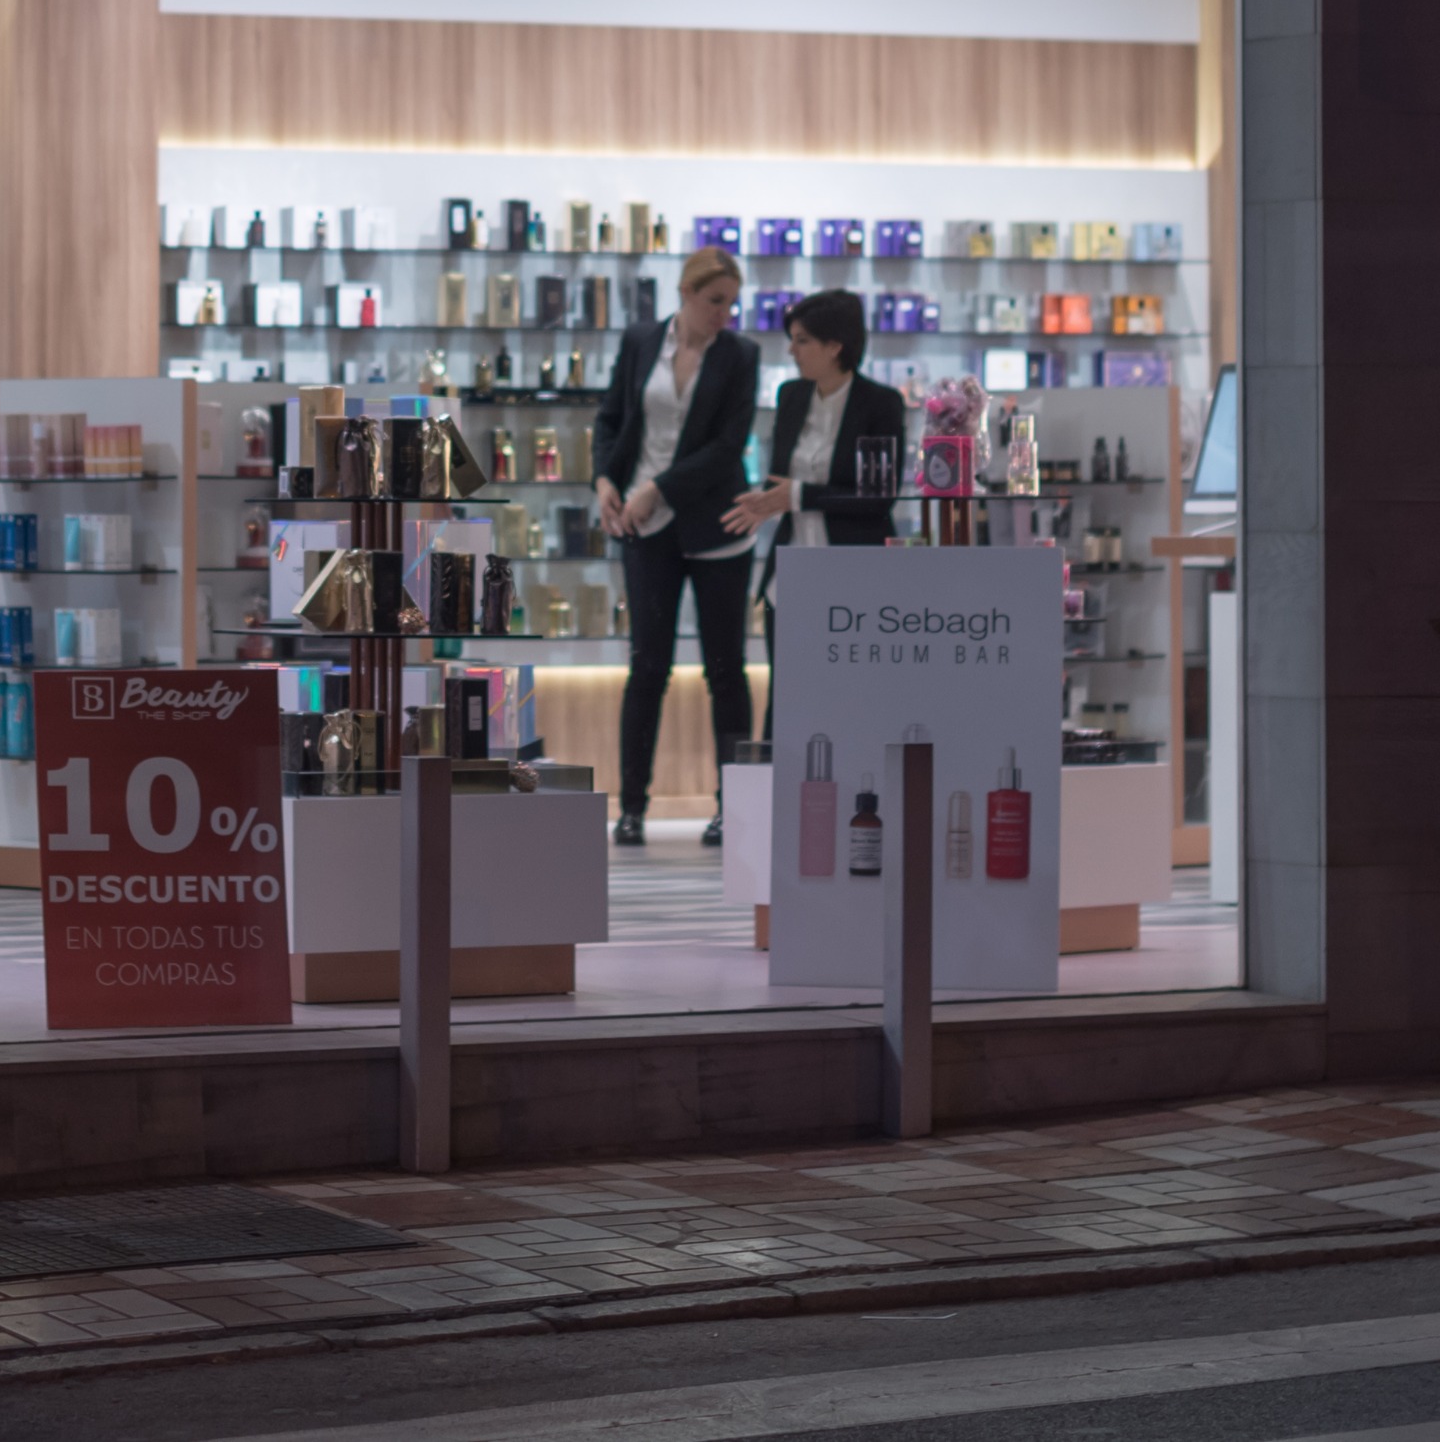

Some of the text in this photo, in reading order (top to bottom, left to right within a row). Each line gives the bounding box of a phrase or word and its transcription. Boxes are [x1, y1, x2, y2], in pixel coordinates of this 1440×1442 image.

[827, 605, 1011, 641] Dr Sebagh
[828, 643, 1010, 665] SERUM BAR
[82, 677, 250, 721] B Beauty
[137, 710, 212, 721] THE SHOP
[47, 756, 279, 854] 10%
[48, 874, 281, 904] DESCUENTO
[66, 925, 264, 950] EN TODAS TUS
[95, 962, 237, 986] COMPRAS
